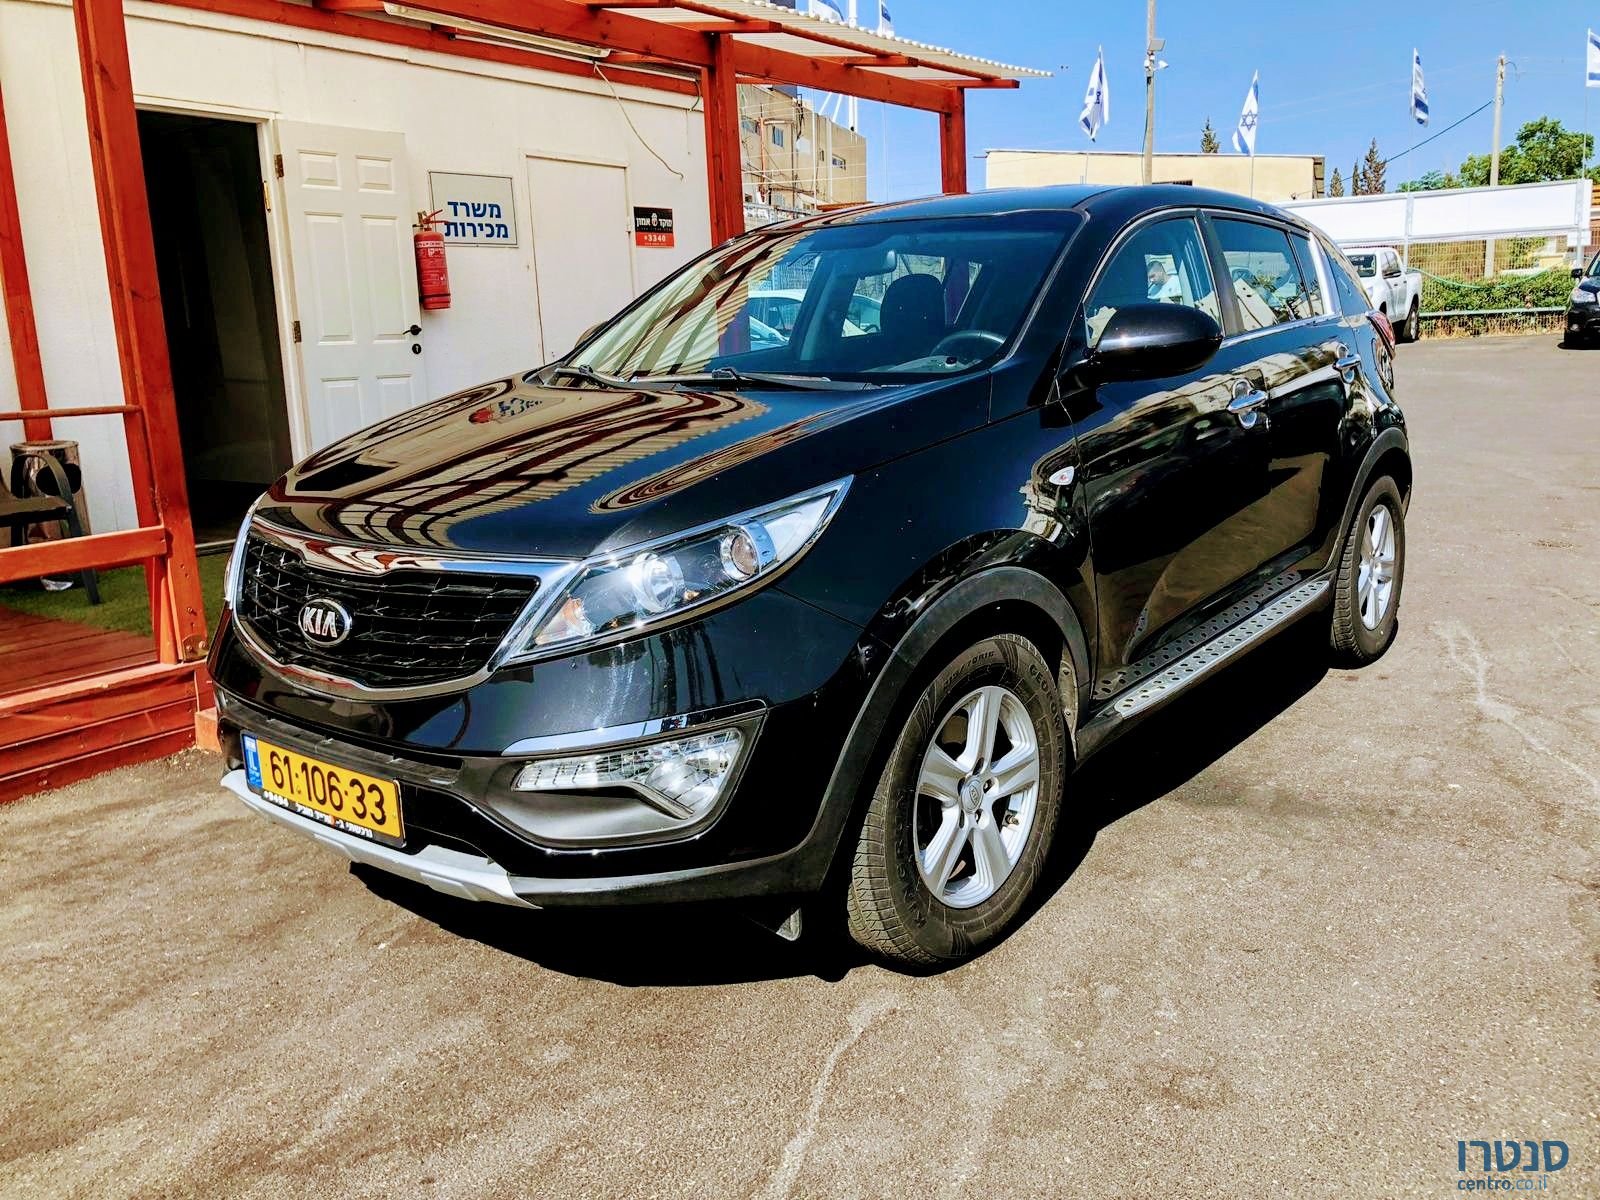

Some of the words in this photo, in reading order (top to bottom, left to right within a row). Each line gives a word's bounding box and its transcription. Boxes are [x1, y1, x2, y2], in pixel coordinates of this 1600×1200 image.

[448, 201, 501, 218] משרד
[444, 222, 509, 238] מכירות
[303, 606, 338, 638] KIA
